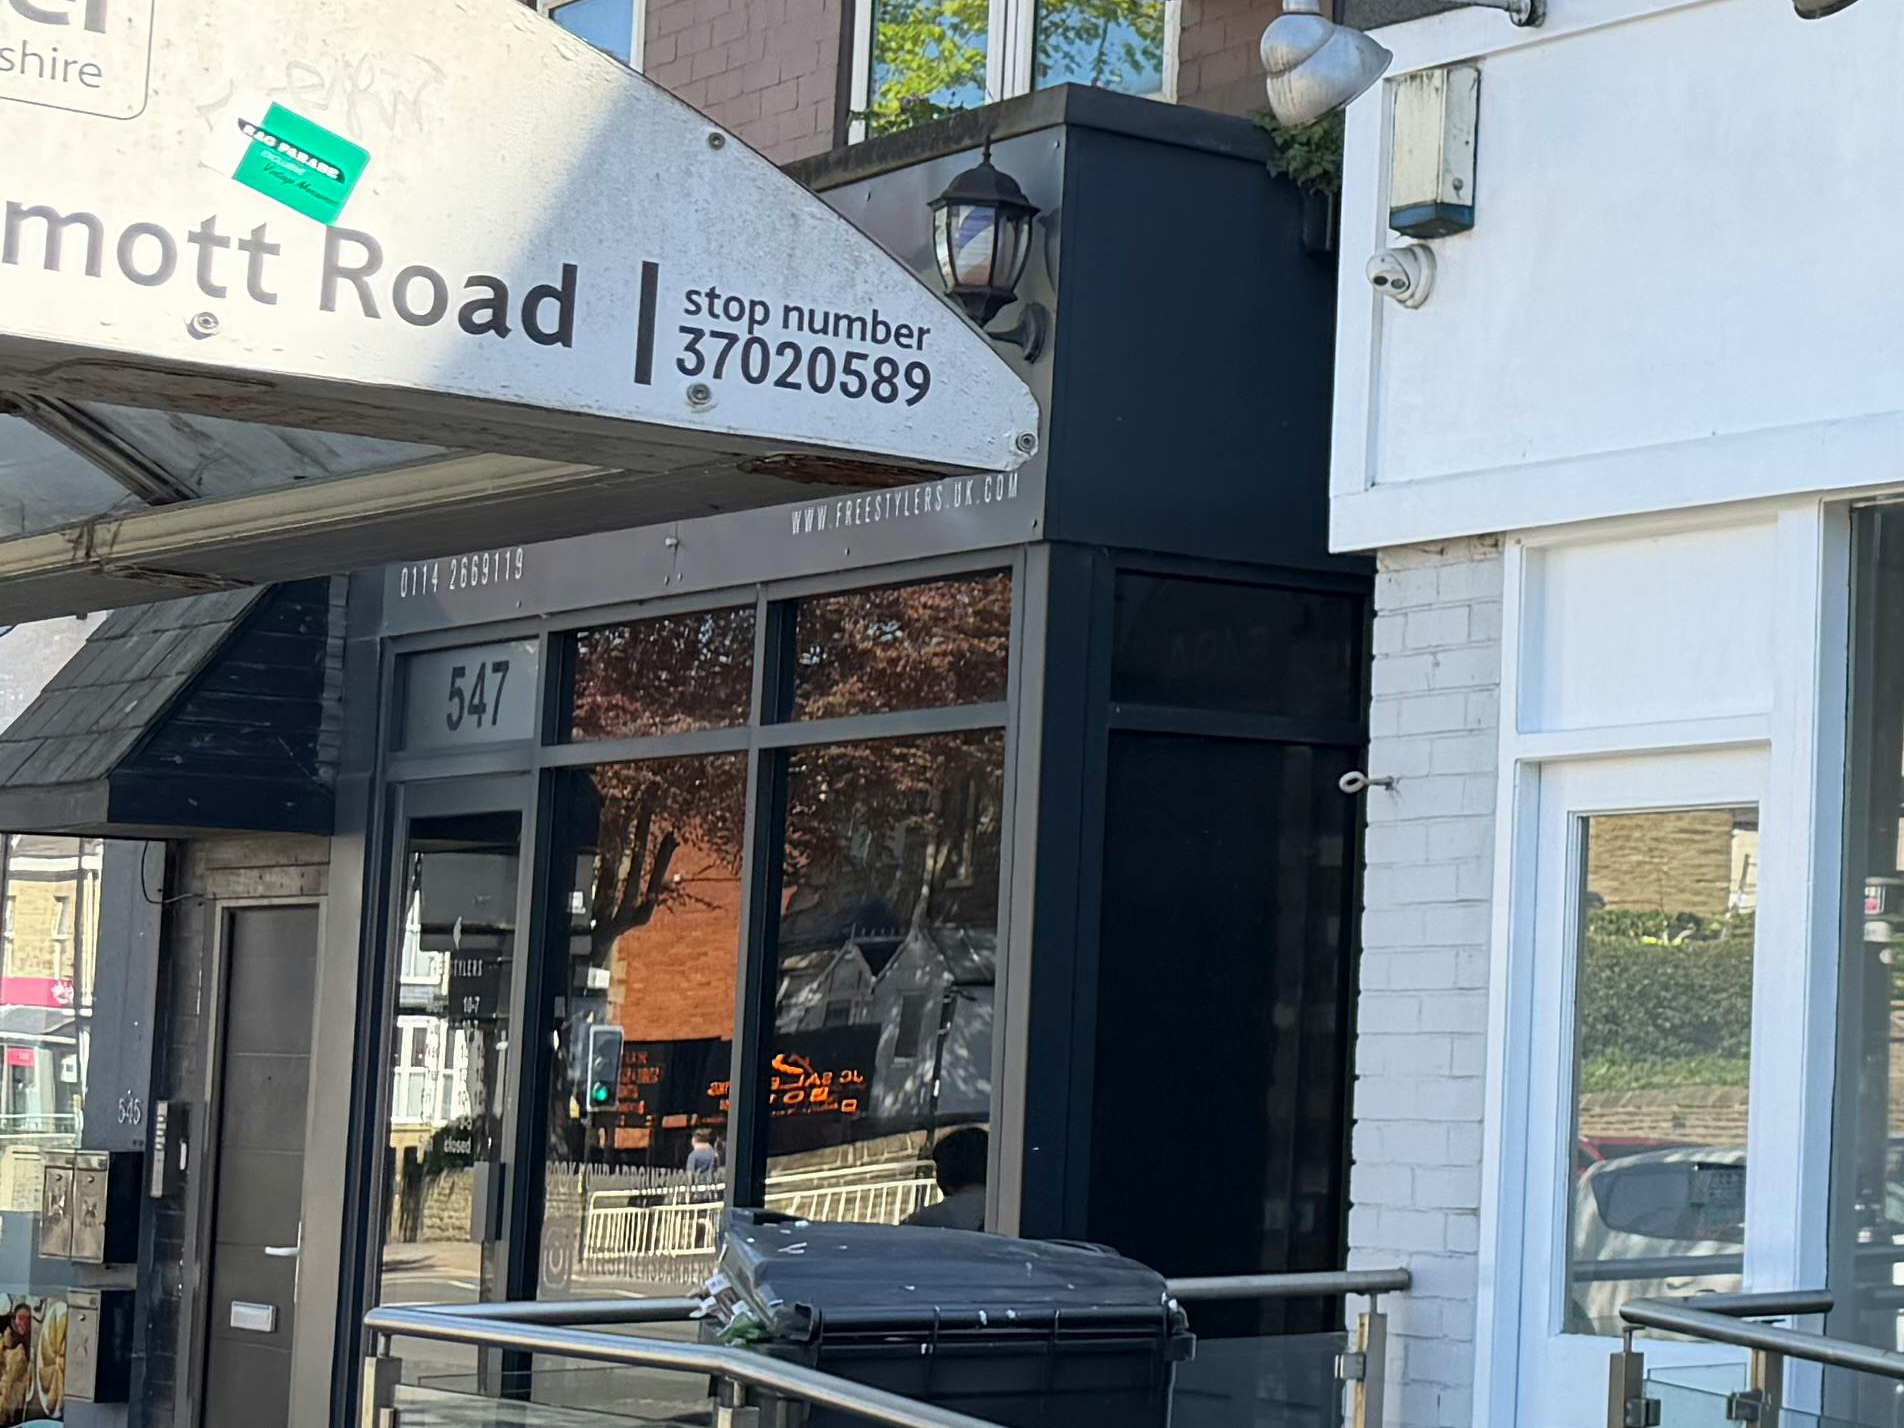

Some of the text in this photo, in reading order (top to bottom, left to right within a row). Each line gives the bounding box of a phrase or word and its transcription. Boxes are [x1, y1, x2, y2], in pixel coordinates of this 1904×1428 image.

[319, 226, 578, 349] Road
[684, 283, 932, 352] stop number
[675, 325, 932, 408] 37020589
[791, 472, 1020, 536] WWW.FREESTYLERS.UK.COM
[399, 545, 525, 599] 0114 2669119
[445, 659, 511, 732] 547
